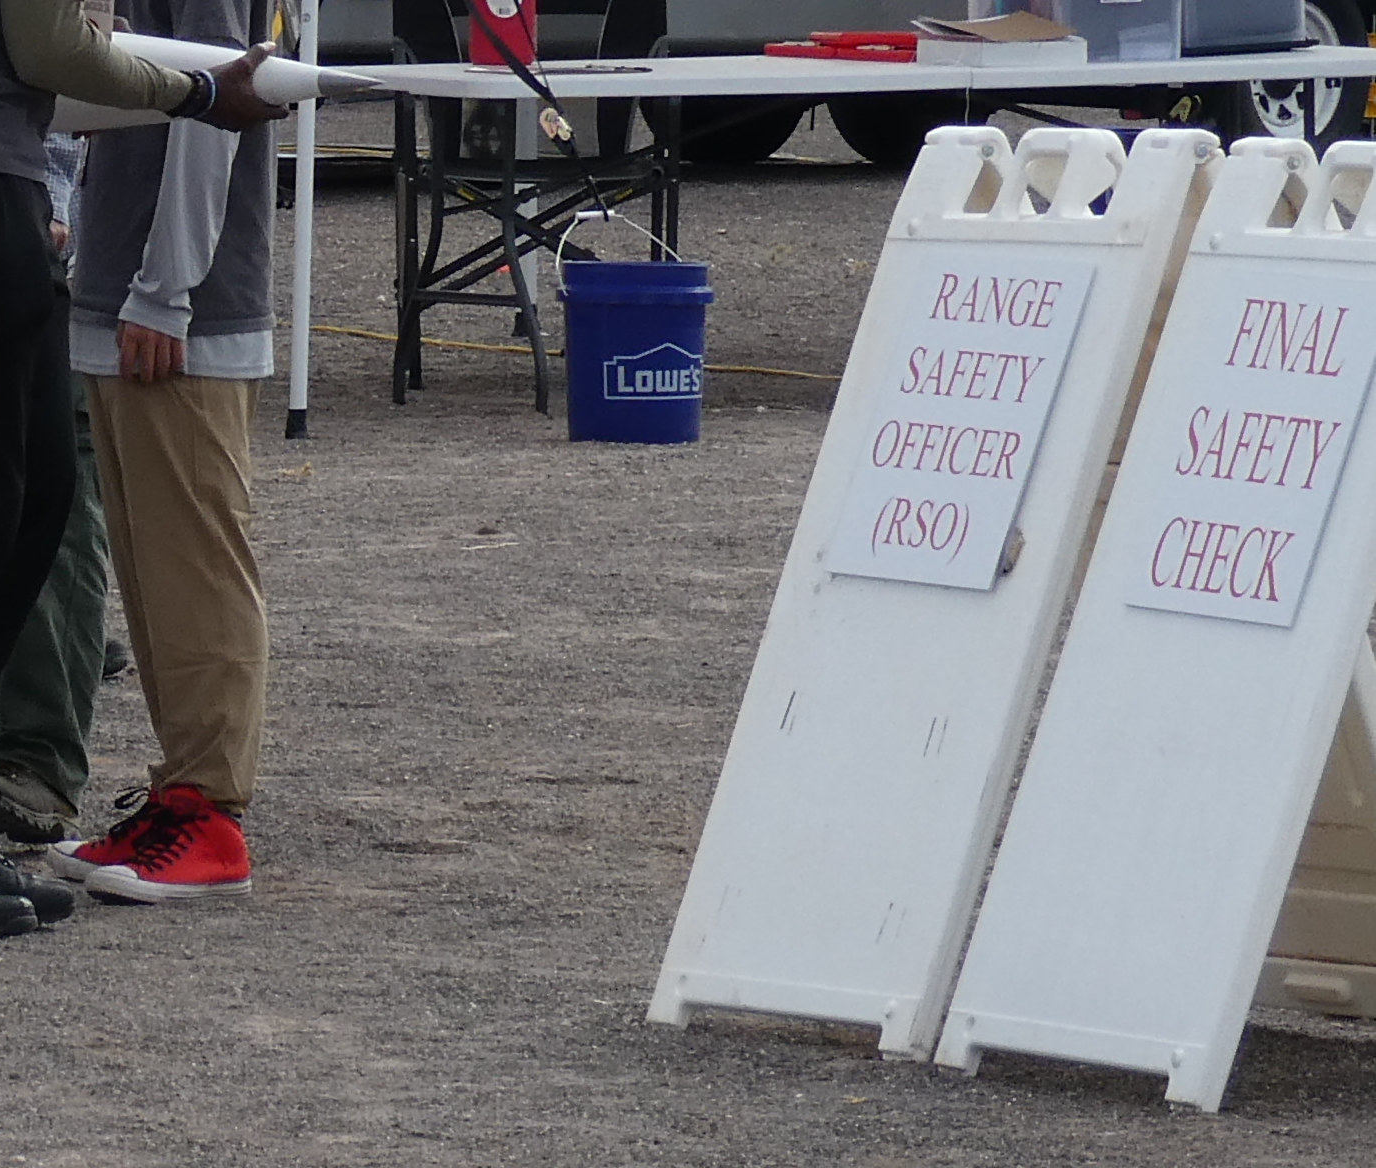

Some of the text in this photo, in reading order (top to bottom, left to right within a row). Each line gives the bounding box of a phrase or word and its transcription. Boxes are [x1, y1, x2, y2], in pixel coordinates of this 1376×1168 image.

[929, 273, 1062, 328] RANGE
[1225, 298, 1349, 377] FINAL
[900, 346, 1046, 403] SAFETY
[873, 420, 1021, 479] OFFICER
[1176, 405, 1341, 490] SAFETY
[871, 496, 970, 565] (RSO)
[1151, 516, 1295, 602] CHECK
